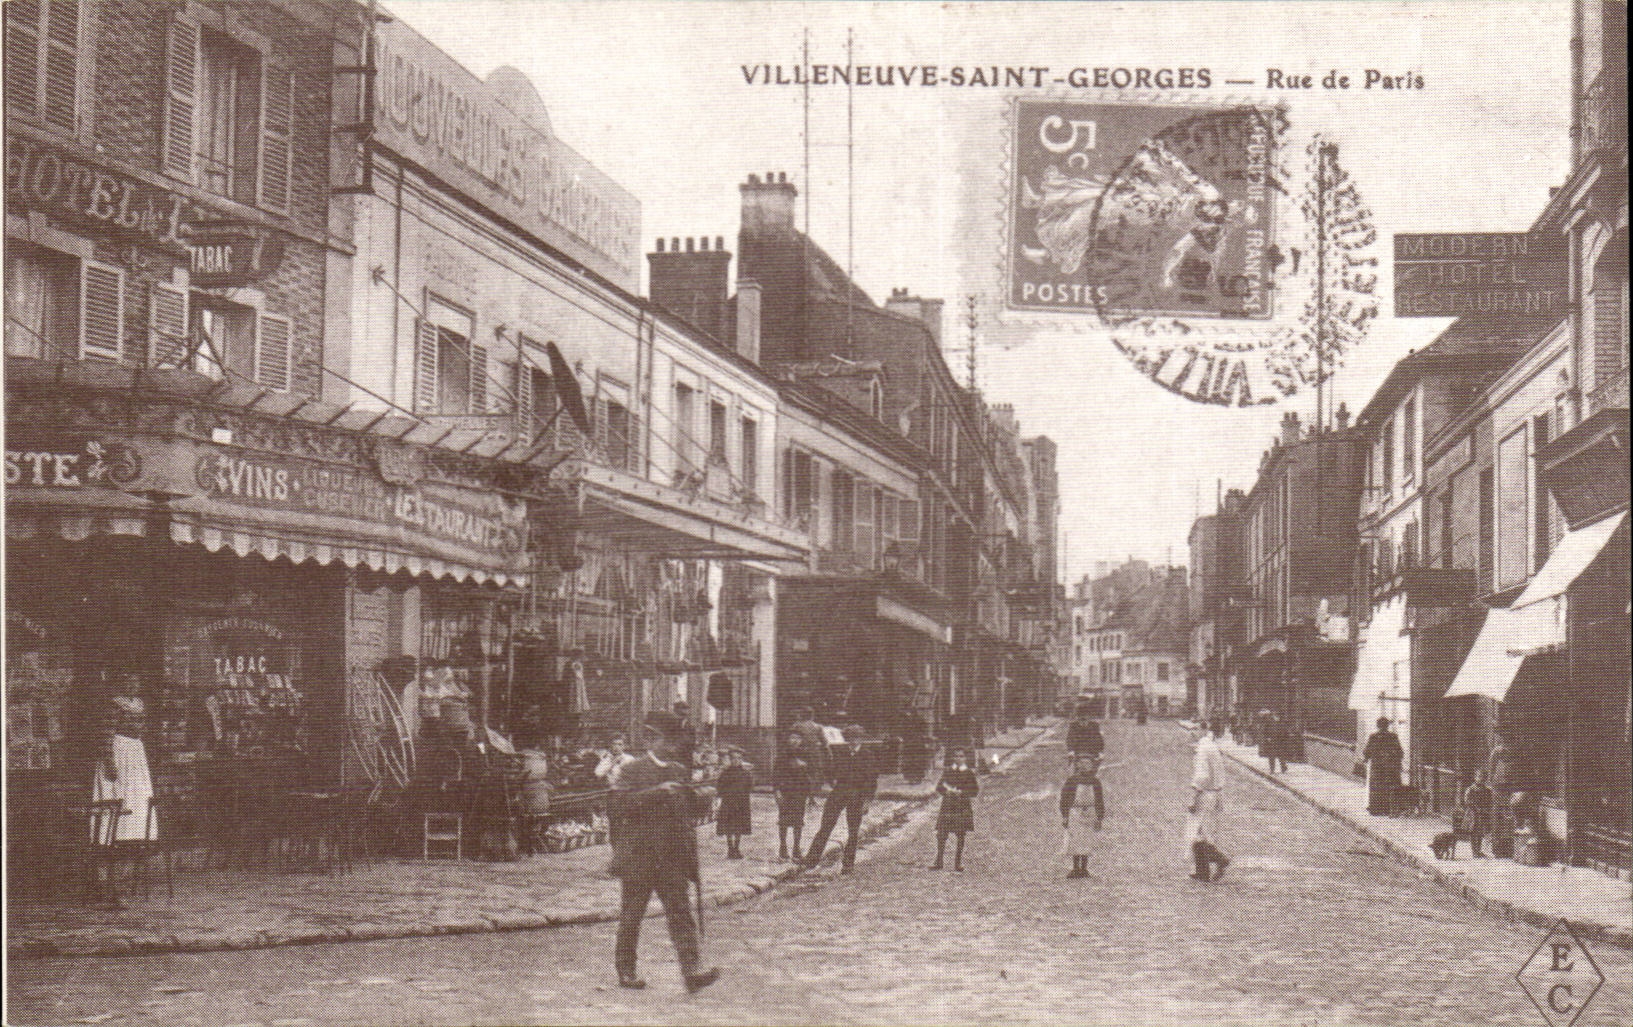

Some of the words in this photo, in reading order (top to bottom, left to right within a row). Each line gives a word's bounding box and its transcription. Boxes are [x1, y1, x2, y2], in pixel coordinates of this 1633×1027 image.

[190, 245, 233, 273] TABAC
[1022, 282, 1109, 306] POSTES
[1398, 290, 1554, 313] RESTAURANT
[229, 458, 289, 501] VINS
[214, 655, 266, 675] TABAC
